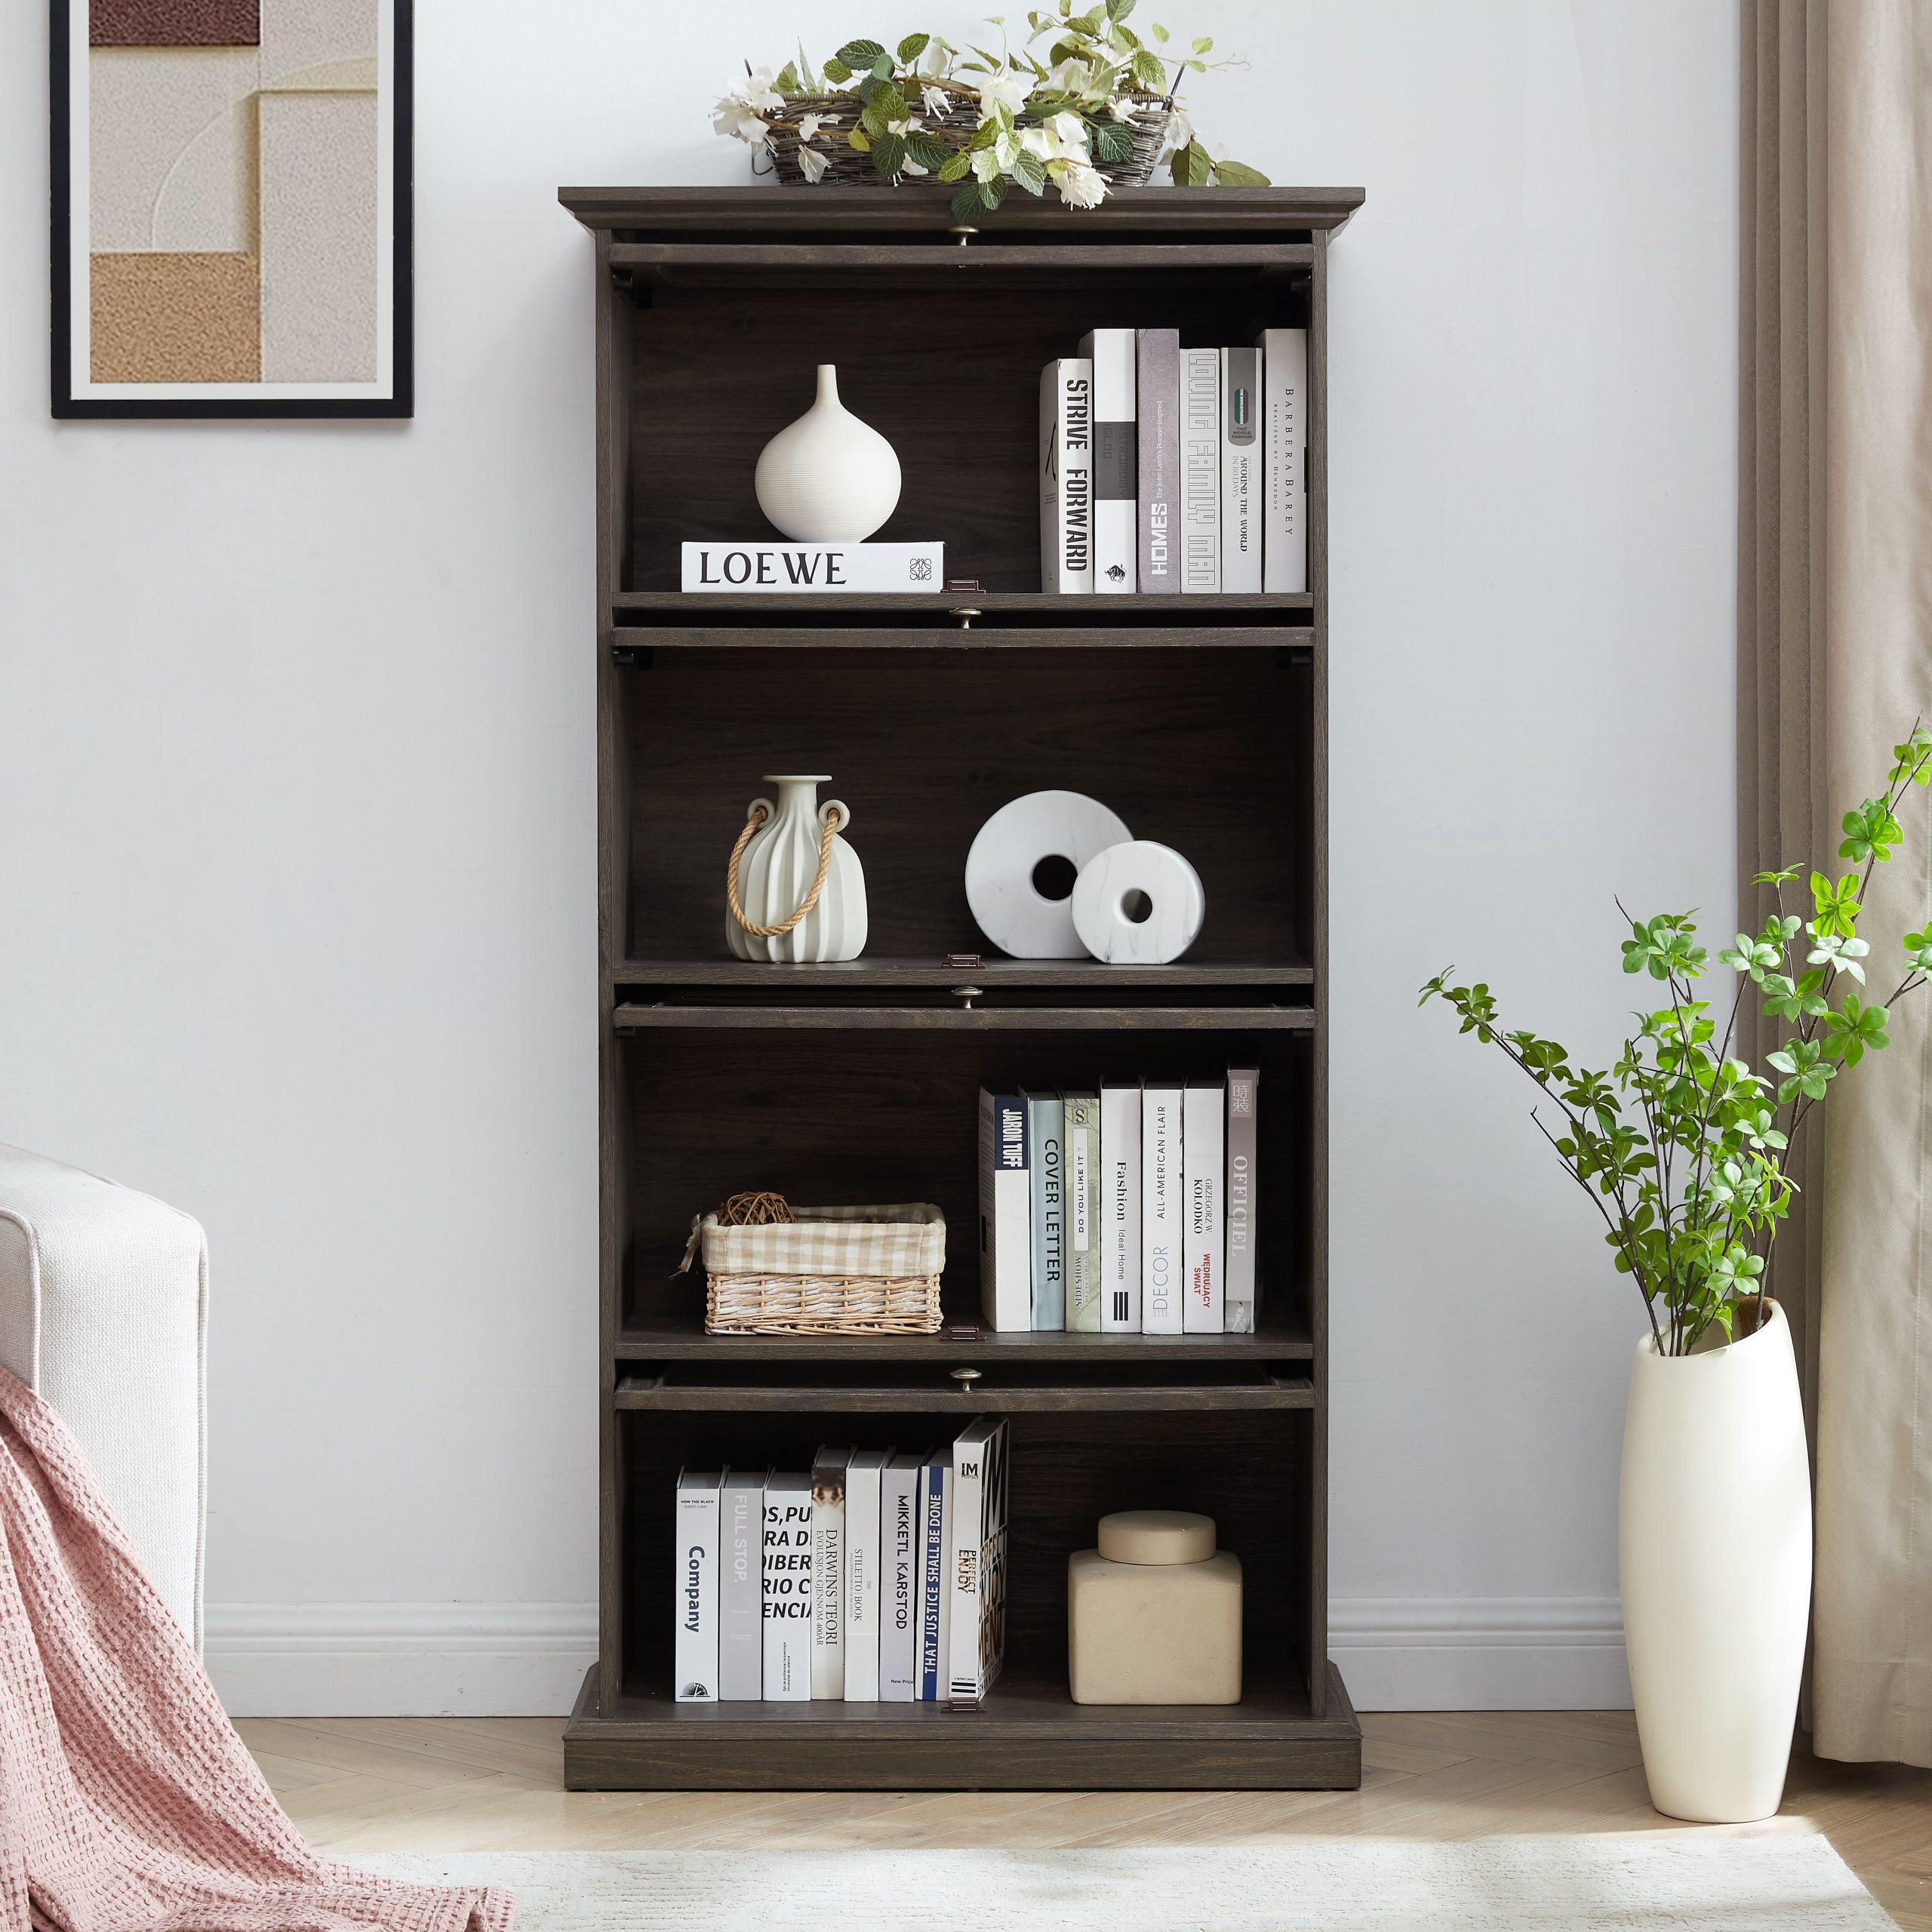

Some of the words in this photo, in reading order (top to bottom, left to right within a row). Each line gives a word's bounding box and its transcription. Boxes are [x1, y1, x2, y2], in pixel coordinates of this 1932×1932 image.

[1189, 353, 1216, 429] LOVING
[1066, 380, 1088, 450] STRIVE
[1285, 389, 1294, 471] BARBERA
[1103, 423, 1112, 459] IGLOO
[1232, 456, 1238, 464] IN
[1273, 451, 1278, 459] BY
[1188, 441, 1216, 524] FAMILY
[1232, 467, 1238, 476] 80
[1066, 469, 1088, 571] FORWARD
[1285, 479, 1294, 534] BAREY
[1152, 503, 1168, 575] HOMES
[700, 552, 847, 585] LOEWE
[1188, 535, 1216, 586] MAN
[1002, 1109, 1023, 1141] JARON
[1075, 1109, 1084, 1122] S
[1158, 1106, 1166, 1134] FLAIR
[1002, 1143, 1023, 1167] TUFF
[1044, 1139, 1059, 1204] COVER
[1078, 1155, 1084, 1164] IT
[1117, 1161, 1127, 1221] Fashion
[1158, 1140, 1166, 1219] ALL-AMERICAN
[1078, 1219, 1084, 1232] DO
[1194, 1179, 1203, 1234] KOLODKO
[1232, 1155, 1248, 1257] OFFICIEL
[1046, 1211, 1060, 1281] LETTER
[1118, 1229, 1126, 1251] Ideal
[1204, 1225, 1213, 1235] W.
[1118, 1254, 1126, 1280] Home
[1153, 1246, 1168, 1309] DECOR
[1194, 1267, 1202, 1295] ŚWIAT
[1201, 1253, 1211, 1308] WĘDRUJĄCY
[961, 1463, 978, 1475] IM
[734, 1495, 747, 1534] FULL
[763, 1506, 811, 1525] S,PU
[897, 1495, 909, 1556] MIKKETL
[930, 1494, 941, 1527] DONE
[764, 1531, 789, 1546] RA
[795, 1531, 811, 1546] D
[815, 1531, 823, 1577] EVOLUSJON
[929, 1530, 940, 1543] BE
[734, 1539, 747, 1583] STOP.
[763, 1554, 811, 1570] IBER
[826, 1529, 838, 1597] DARWINS
[854, 1549, 863, 1592] STILETTO
[928, 1546, 940, 1583] SHALL
[958, 1549, 969, 1593] ENJOY
[968, 1549, 977, 1594] PERFECT
[685, 1546, 705, 1632] Company
[815, 1580, 823, 1620] GJENNOM
[854, 1596, 863, 1621] BOOK
[896, 1562, 908, 1629] KARSTOD
[826, 1601, 838, 1645] TEORI
[926, 1587, 938, 1637] JUSTICE
[816, 1623, 824, 1645] 400ÅR
[924, 1641, 937, 1673] THAT
